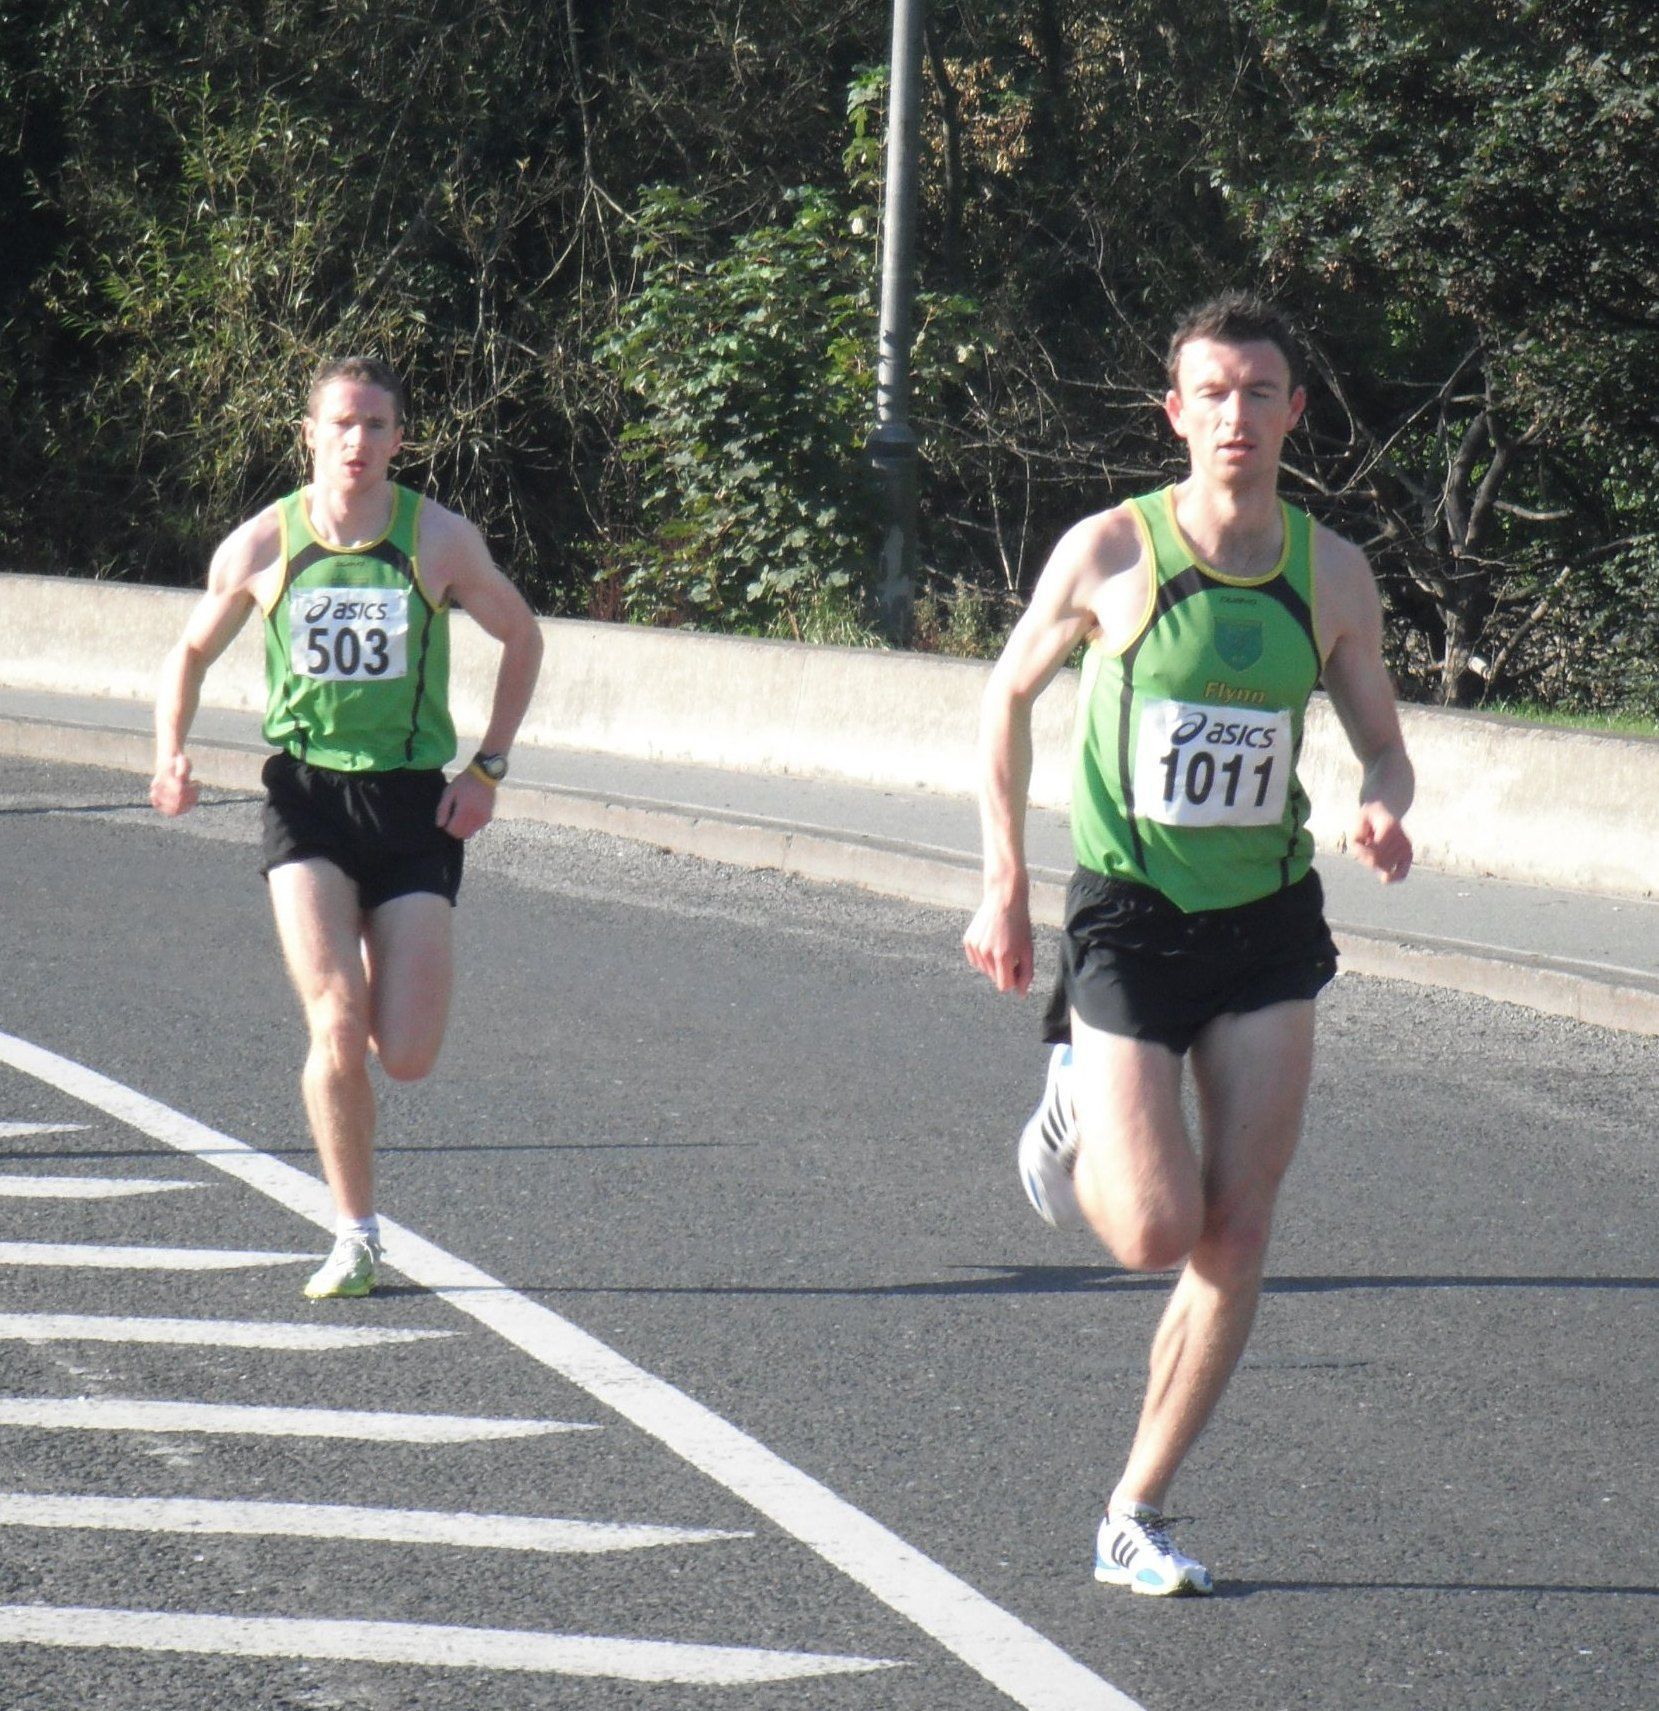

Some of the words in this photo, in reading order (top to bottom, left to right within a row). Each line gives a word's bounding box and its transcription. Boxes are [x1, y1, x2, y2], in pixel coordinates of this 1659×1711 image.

[333, 602, 388, 620] asics
[307, 627, 389, 676] 503
[1204, 682, 1266, 704] Flynn
[1205, 722, 1277, 749] asics
[1160, 747, 1275, 807] 1011
